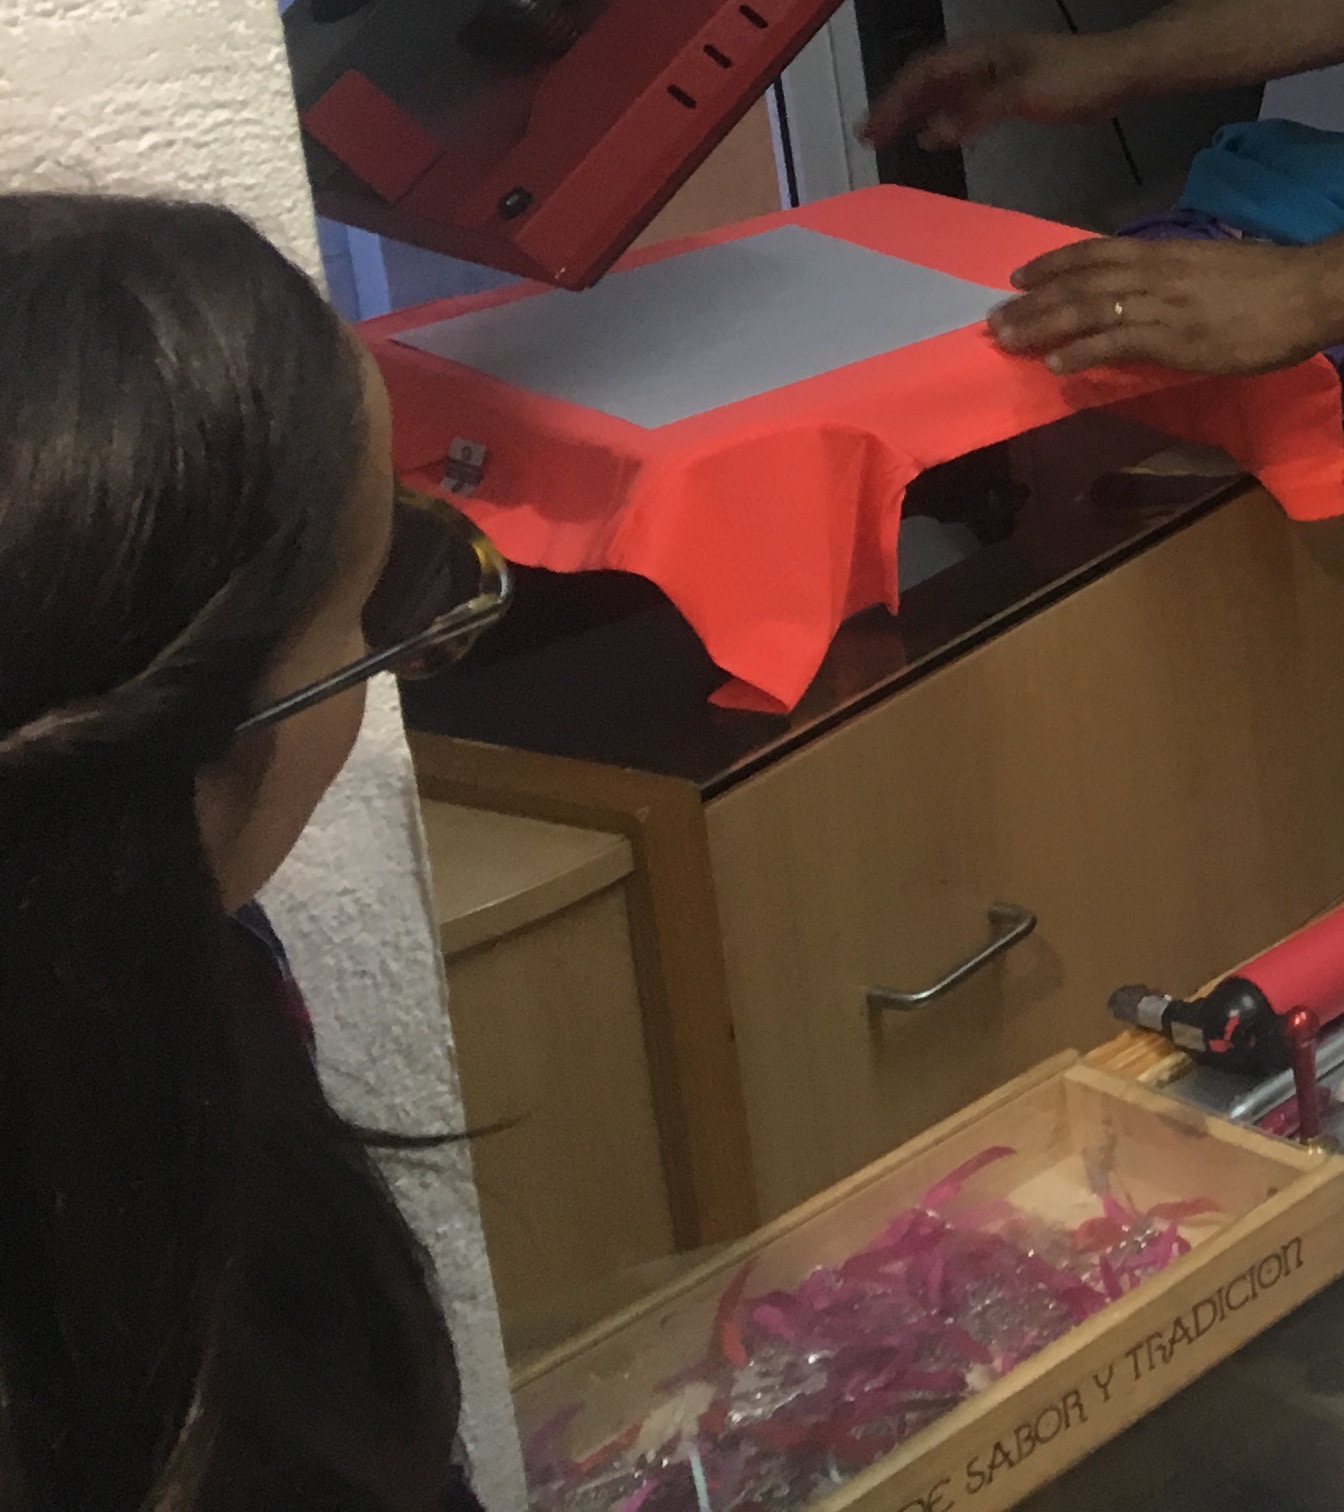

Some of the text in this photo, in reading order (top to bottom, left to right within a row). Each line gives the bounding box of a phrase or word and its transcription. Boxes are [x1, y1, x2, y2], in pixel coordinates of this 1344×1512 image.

[965, 1389, 1088, 1494] SABOR
[1094, 1366, 1116, 1402] Y
[1126, 1236, 1303, 1381] TRADICION
